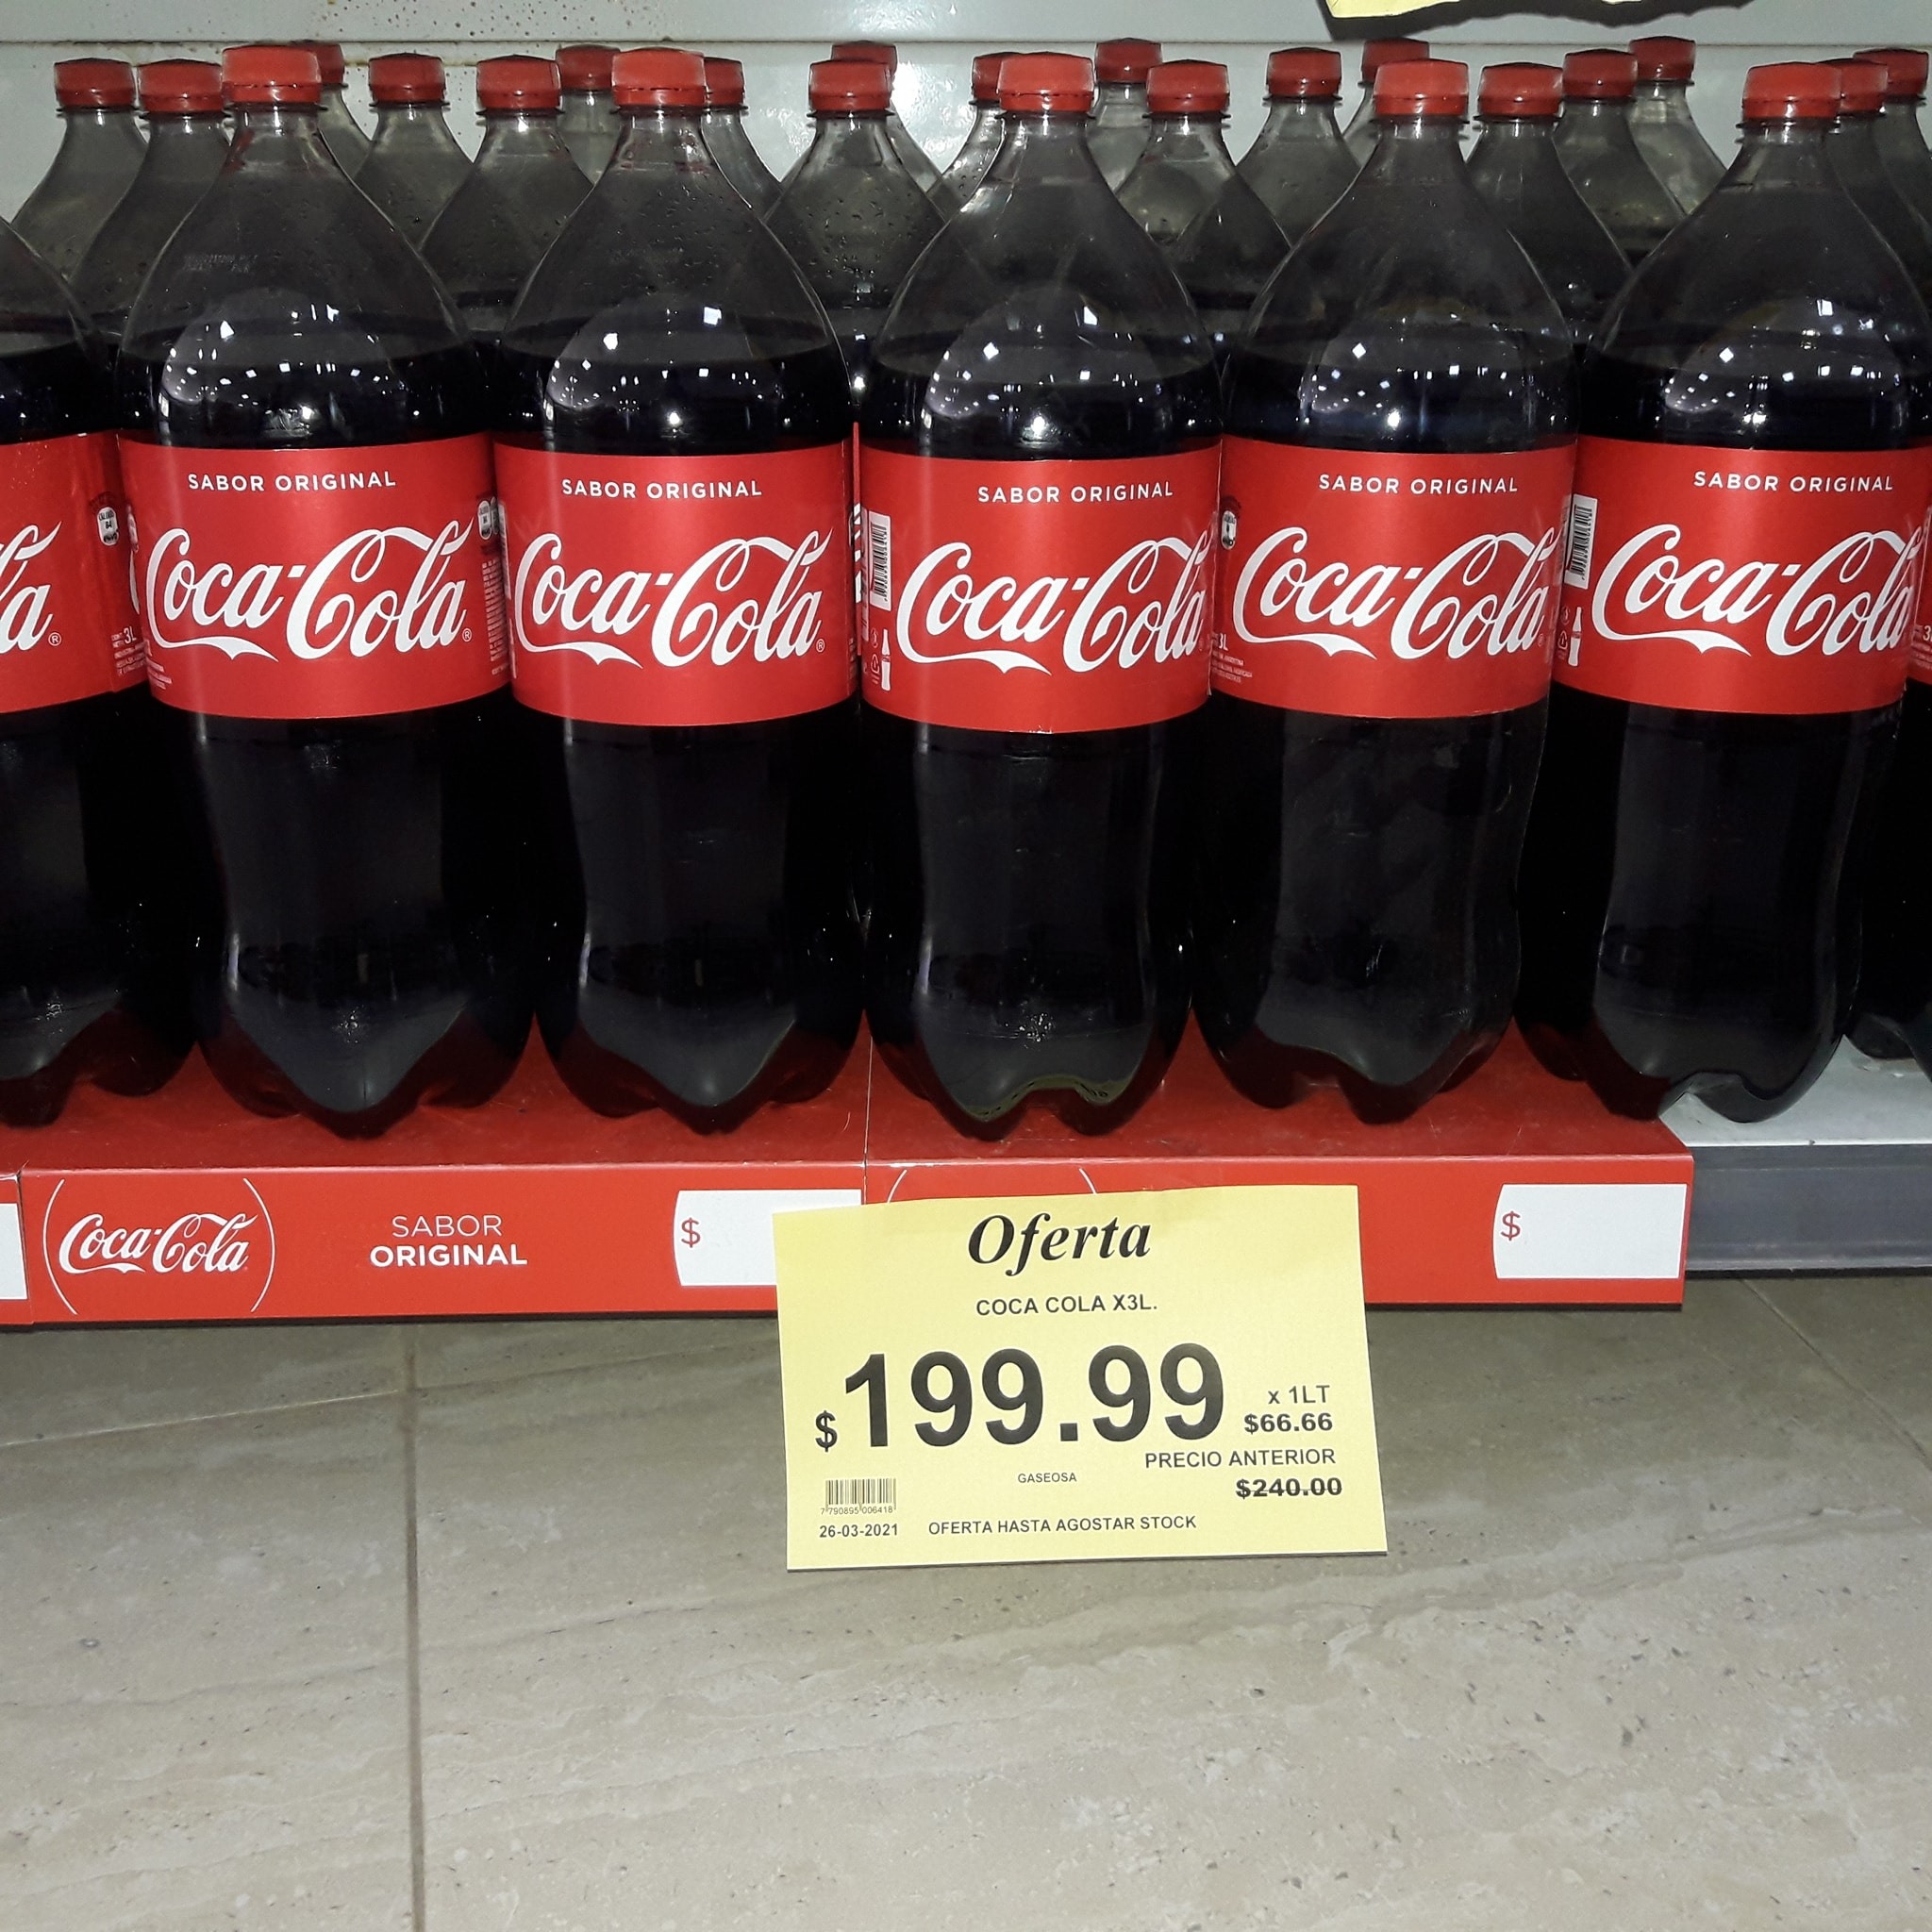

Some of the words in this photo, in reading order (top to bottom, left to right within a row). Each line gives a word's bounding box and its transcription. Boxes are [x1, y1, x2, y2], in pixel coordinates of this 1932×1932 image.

[188, 474, 265, 491] SABOR
[275, 471, 396, 491] ORIGINAL
[561, 478, 636, 499] SABOR
[646, 480, 762, 499] ORIGINAL
[978, 486, 1059, 504] SABOR
[1070, 481, 1174, 503] ORIGINAL
[1319, 474, 1400, 494] SABOR
[1410, 477, 1518, 495] ORIGINAL
[1693, 471, 1779, 491] SABOR
[1790, 475, 1893, 492] ORIGINAL
[146, 516, 474, 661] Coca-Cola
[515, 527, 833, 669] Coca-Cola
[1233, 527, 1564, 659] Coca-Cola
[391, 1214, 502, 1238] SABOR
[58, 1213, 258, 1274] Coca-Cola
[968, 1212, 1151, 1277] Oferta
[370, 1243, 528, 1268] ORIGINAL
[975, 1297, 1040, 1316] COCA
[1045, 1294, 1107, 1313] COLA
[1112, 1293, 1158, 1311] X3L.
[1289, 1384, 1330, 1404] 1LT
[1243, 1412, 1333, 1435] $66.66
[1145, 1451, 1223, 1469] PRECIO
[1228, 1448, 1337, 1467] ANTERIOR
[1017, 1472, 1077, 1484] GASEOSA
[1235, 1477, 1342, 1500] $240.00
[819, 1523, 898, 1539] 26-03-2021
[928, 1521, 993, 1535] OFERTA
[997, 1519, 1052, 1533] HASTA
[1056, 1517, 1135, 1532] AGOSTAR
[1140, 1515, 1197, 1530] STOCK
